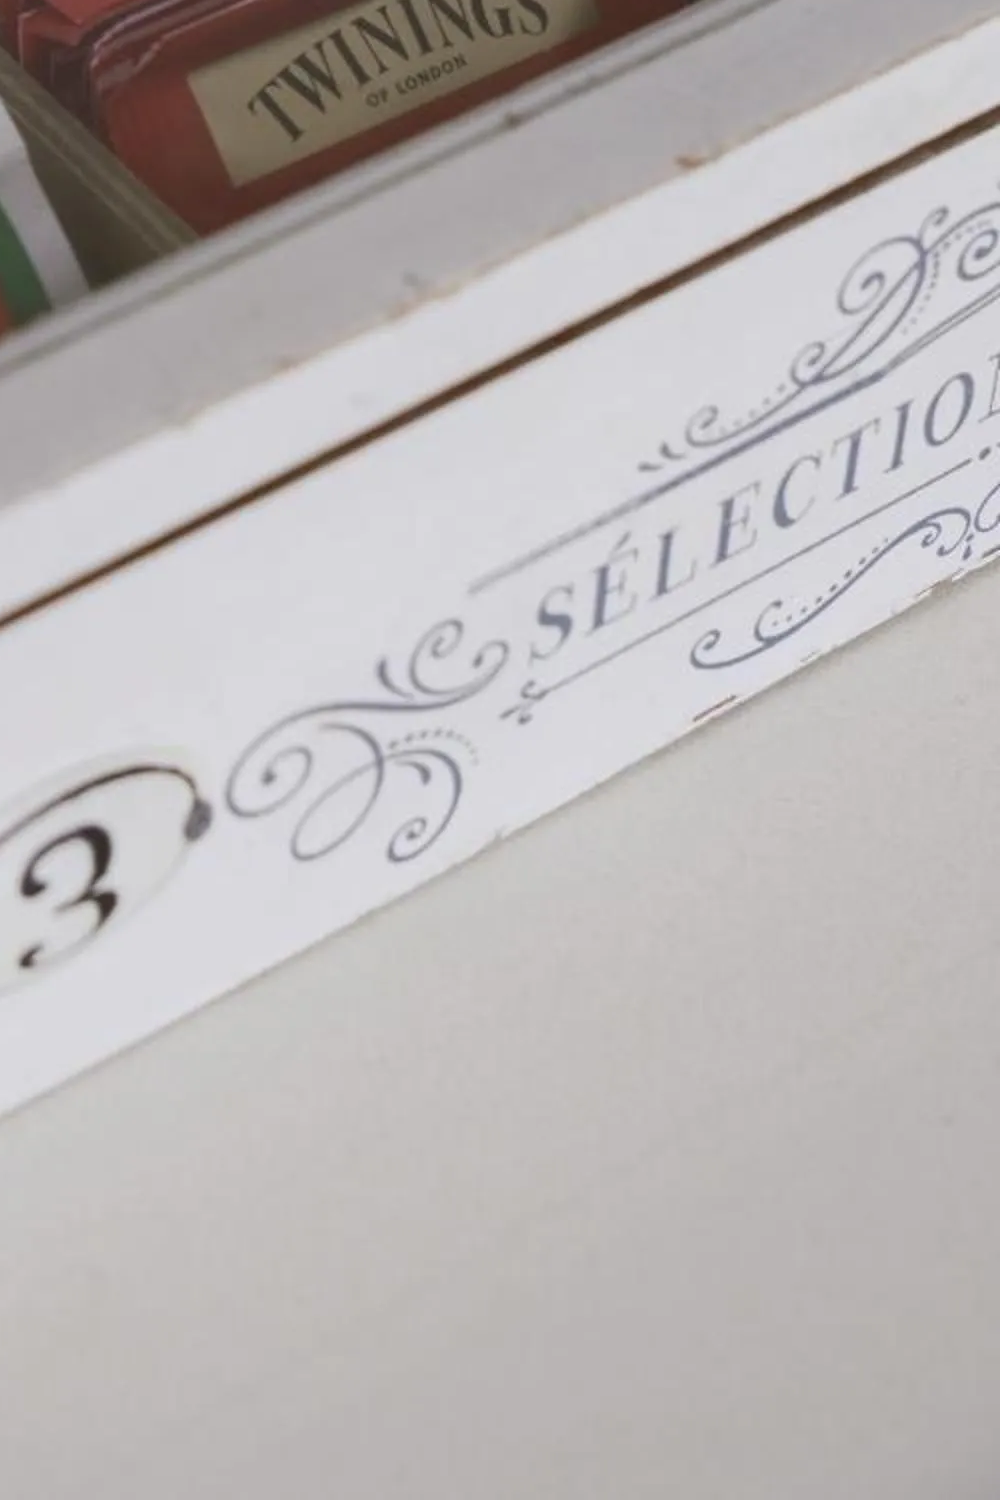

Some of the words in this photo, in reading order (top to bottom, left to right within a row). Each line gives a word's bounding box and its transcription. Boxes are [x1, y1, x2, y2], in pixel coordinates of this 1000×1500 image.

[365, 90, 391, 108] OF
[398, 53, 468, 96] LONDON
[18, 824, 121, 969] 3
